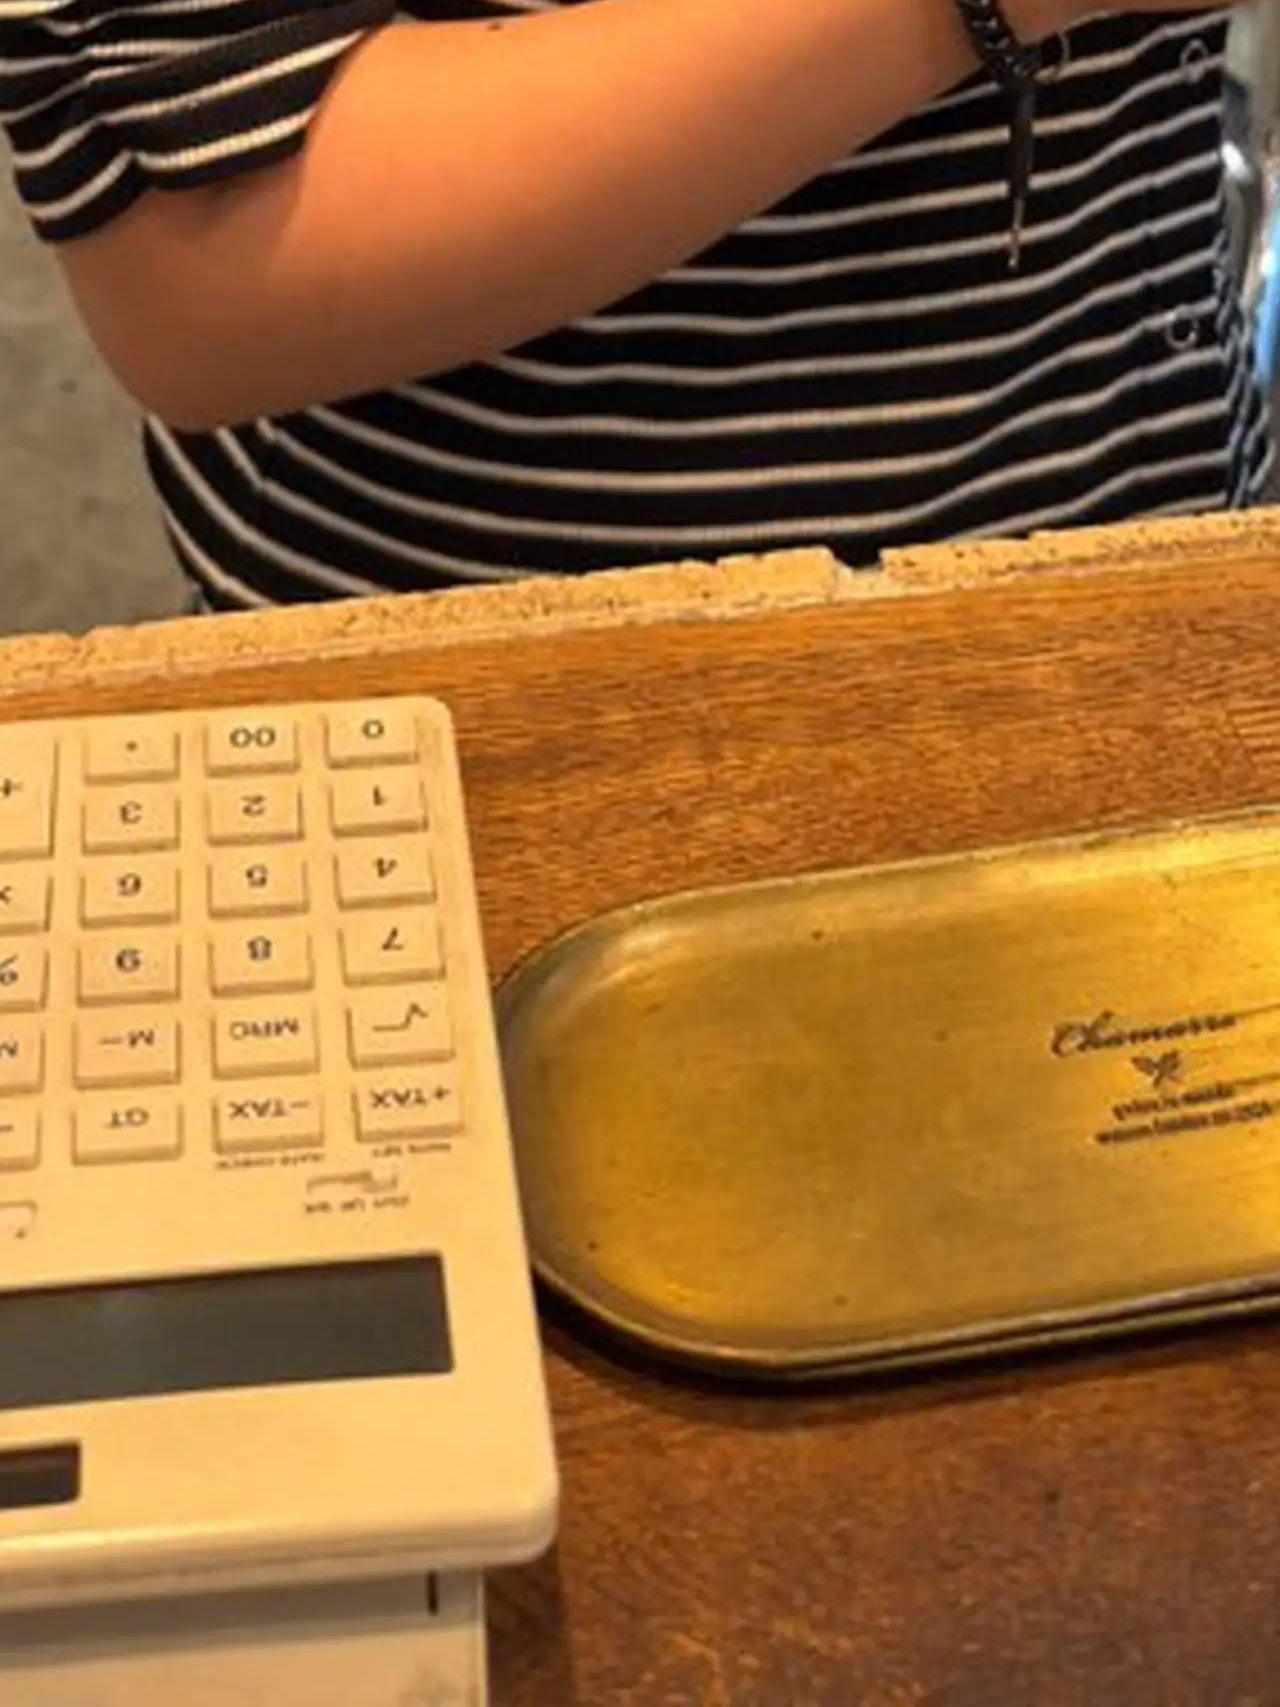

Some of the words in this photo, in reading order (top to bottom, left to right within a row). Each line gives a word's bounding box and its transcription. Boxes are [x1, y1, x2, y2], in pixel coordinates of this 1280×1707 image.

[228, 726, 277, 749] 00
[360, 718, 386, 741] 0
[240, 794, 267, 818] 2
[372, 788, 386, 807] 1
[118, 800, 143, 826] 3
[244, 864, 269, 889] 5
[374, 856, 398, 879] 4
[116, 872, 143, 897] 6
[246, 935, 273, 962] 8
[380, 926, 404, 952] 7
[114, 948, 142, 974] 9
[228, 1017, 301, 1041] MRC
[369, 1086, 452, 1109] +TAX
[105, 1106, 150, 1130] GT
